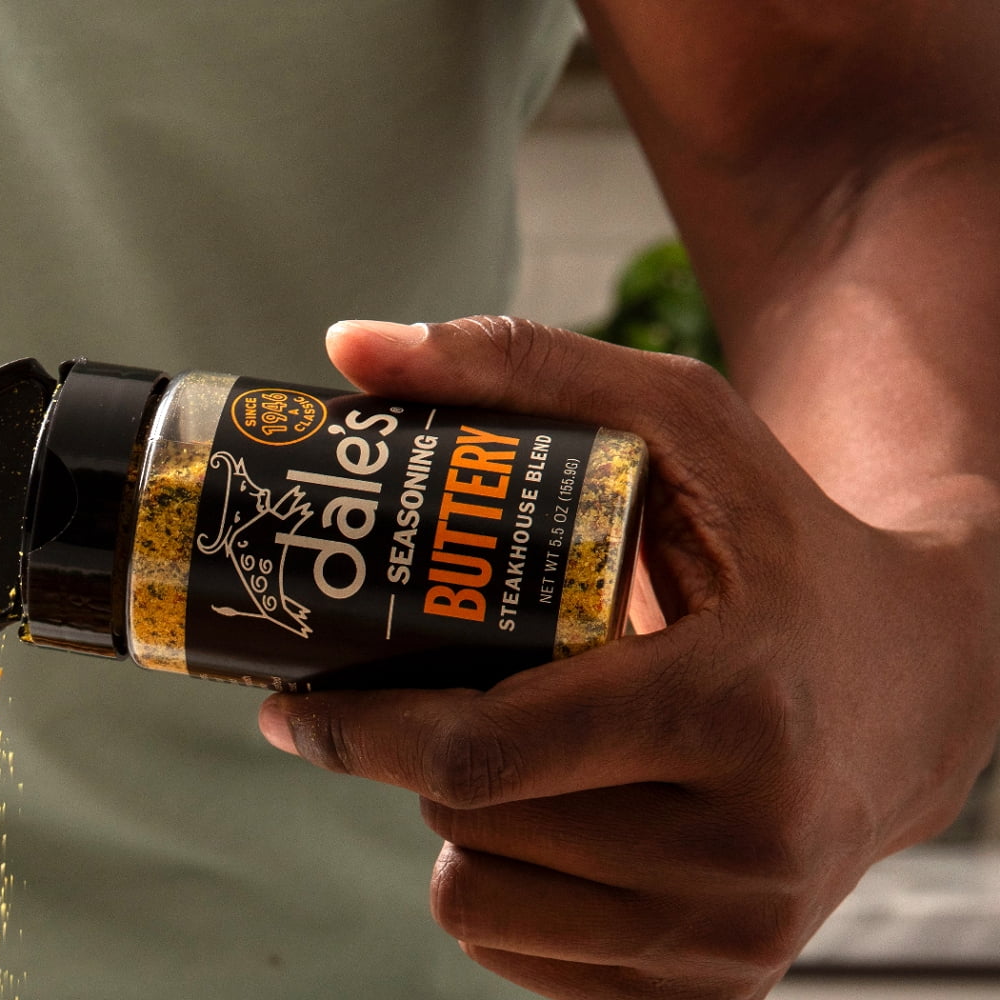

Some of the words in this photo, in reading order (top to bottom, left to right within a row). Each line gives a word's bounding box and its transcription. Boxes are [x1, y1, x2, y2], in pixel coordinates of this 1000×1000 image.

[245, 397, 257, 427] SINCE
[261, 392, 288, 436] 1946
[287, 408, 300, 416] A
[293, 396, 316, 432] CLASSIC
[558, 458, 580, 502] (155.9G)
[386, 434, 439, 586] SEASONING
[423, 424, 521, 623] BUTTERY
[553, 505, 569, 523] OZ
[498, 488, 539, 632] STEAKHOUSE
[525, 434, 552, 483] BLEND
[549, 527, 565, 548] 5.5
[544, 551, 560, 573] WT
[539, 577, 556, 604] NET
